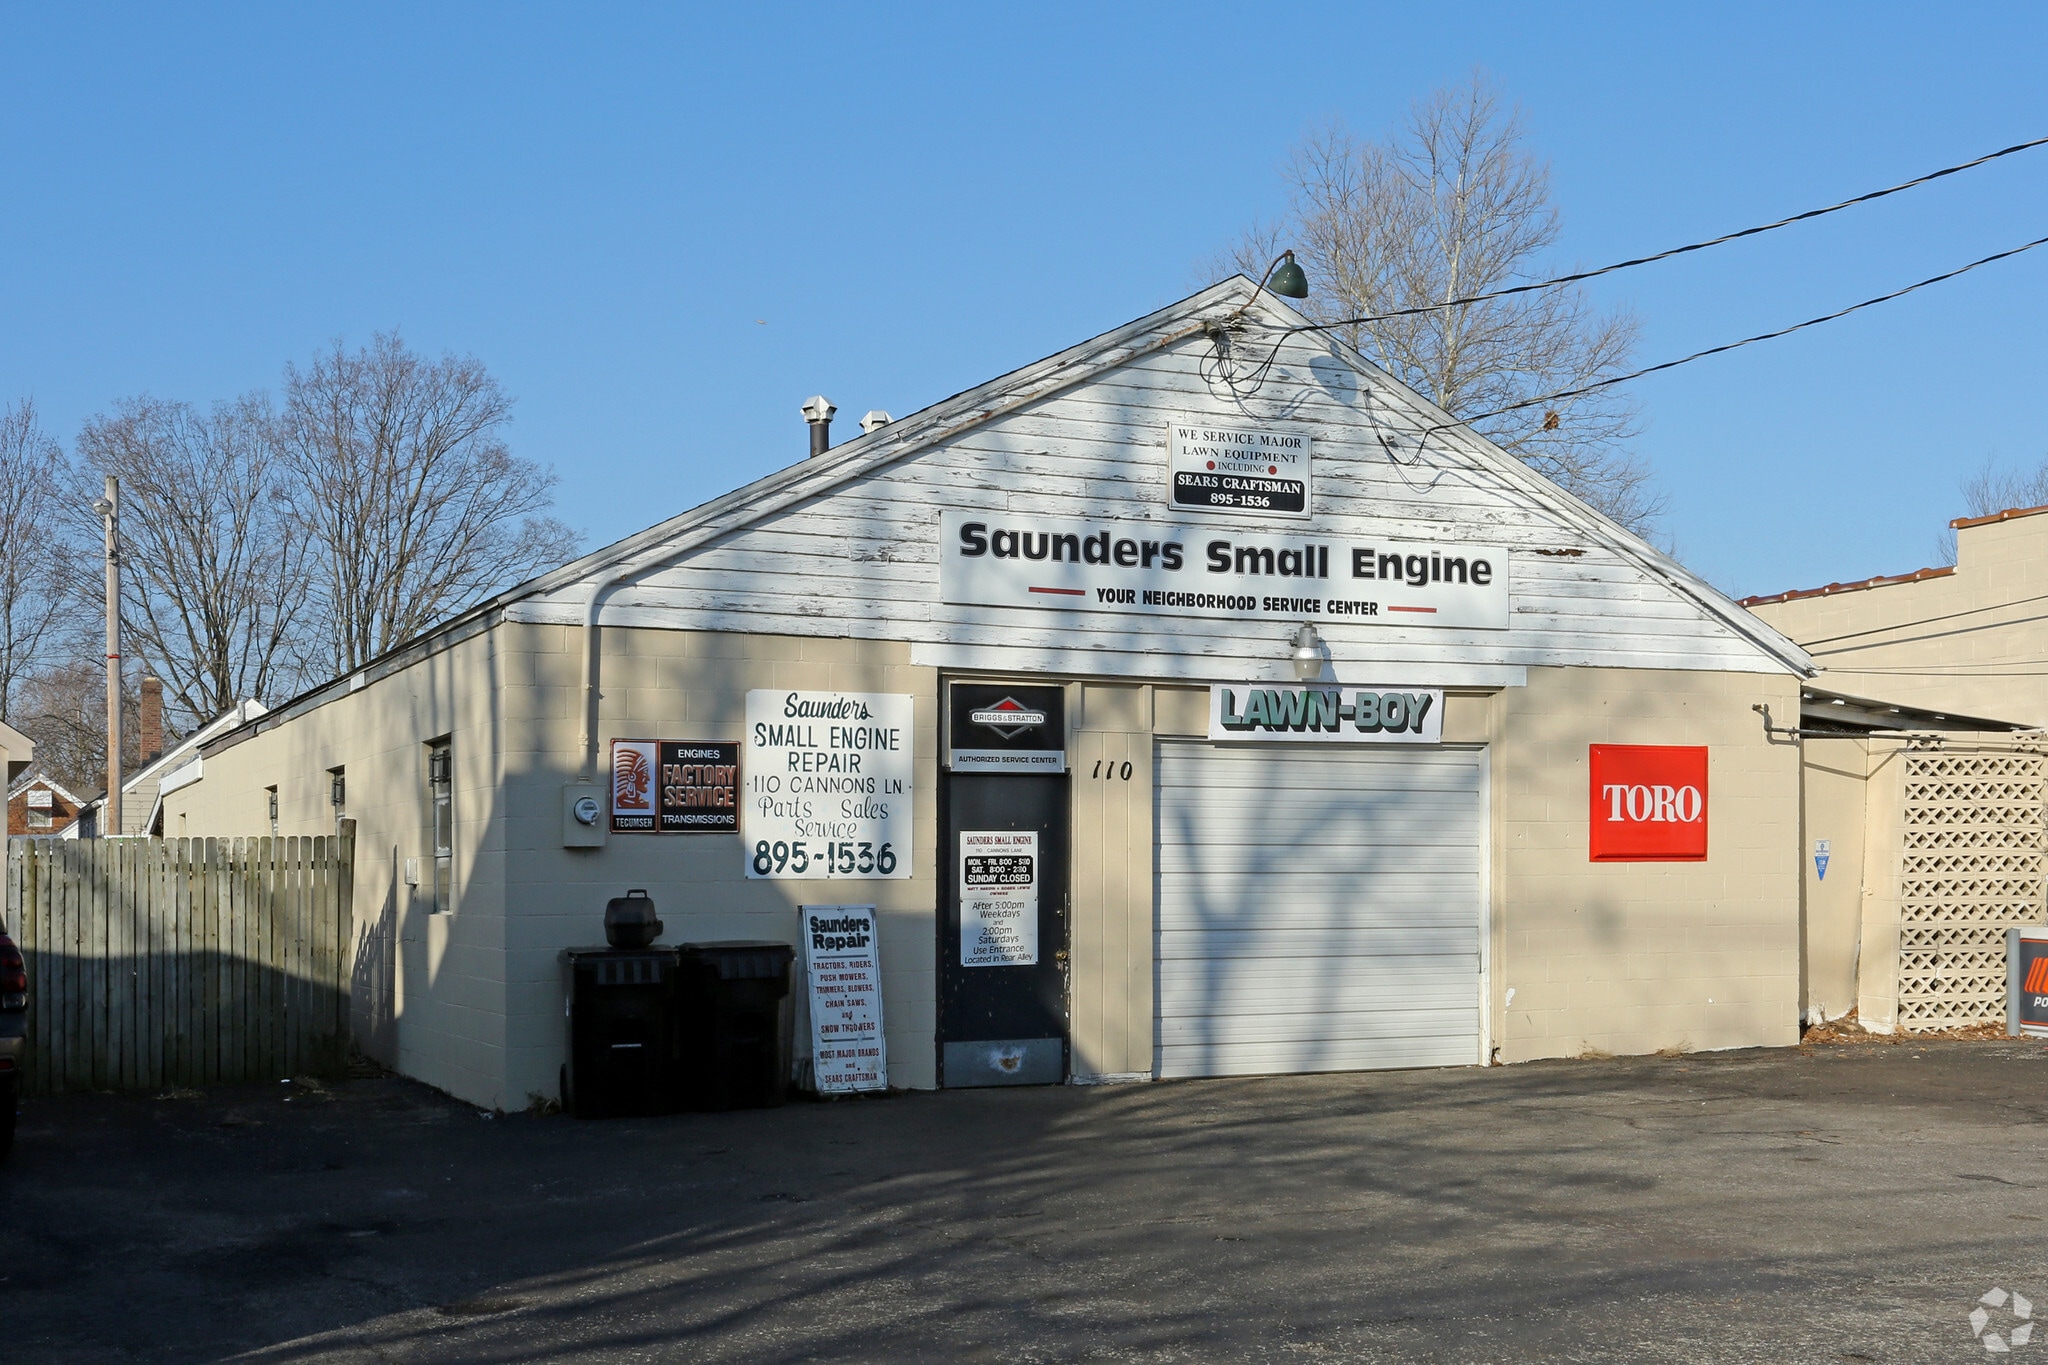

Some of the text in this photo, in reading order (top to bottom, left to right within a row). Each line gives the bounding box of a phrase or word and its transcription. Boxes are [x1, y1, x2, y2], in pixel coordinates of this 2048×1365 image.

[1178, 428, 1302, 449] WE SERVICE MAJOR
[1183, 446, 1298, 463] LAWN EQUIPMENT
[1218, 462, 1265, 473] INCLUDING
[1178, 474, 1301, 494] SEARS CRAFTSMAN
[1210, 492, 1270, 507] 895-1536
[959, 521, 1492, 587] Saunders Small Engine
[1096, 588, 1379, 616] YOUR NEIGHBORHOOD SERVICE CENTER
[784, 692, 874, 720] Saunders
[1220, 689, 1434, 734] LAWN-BOY
[754, 722, 900, 750] SMALL ENGINE
[677, 749, 720, 759] ENGINES
[788, 751, 861, 773] REPAIR
[662, 764, 736, 786] FACTORY
[1093, 760, 1133, 781] 110
[754, 775, 781, 793] 110
[790, 776, 875, 794] CANNONS
[664, 786, 734, 807] SERVICE
[1603, 784, 1702, 823] TORO
[758, 795, 889, 819] Parts Sales
[616, 818, 653, 828] TECUMSEH
[662, 814, 735, 824] TRANSMISSIONS
[795, 818, 858, 839] Service
[966, 836, 1032, 845] SAUNDERS SMALL ENGINE
[753, 840, 897, 875] 895-1536
[968, 874, 1031, 883] SUNDAY CLOSED
[972, 901, 1024, 910] After 5:00pm
[980, 910, 1020, 919] Weekdays
[810, 915, 870, 934] Saunders
[982, 927, 1012, 936] 2:00pm
[812, 933, 870, 951] Repair
[978, 935, 1019, 945] Saturdays
[973, 945, 1024, 955] Use Entrance
[964, 956, 991, 964] Located
[1001, 954, 1015, 962] Rear
[820, 974, 837, 982] PUSH
[825, 1000, 845, 1008] CHAIN
[842, 1010, 853, 1018] and
[821, 1022, 876, 1033] SNOW THROWERS
[820, 1048, 879, 1059] MOST MAJOR BRANDS
[825, 1073, 877, 1083] SEARS CRAFTSMAN
